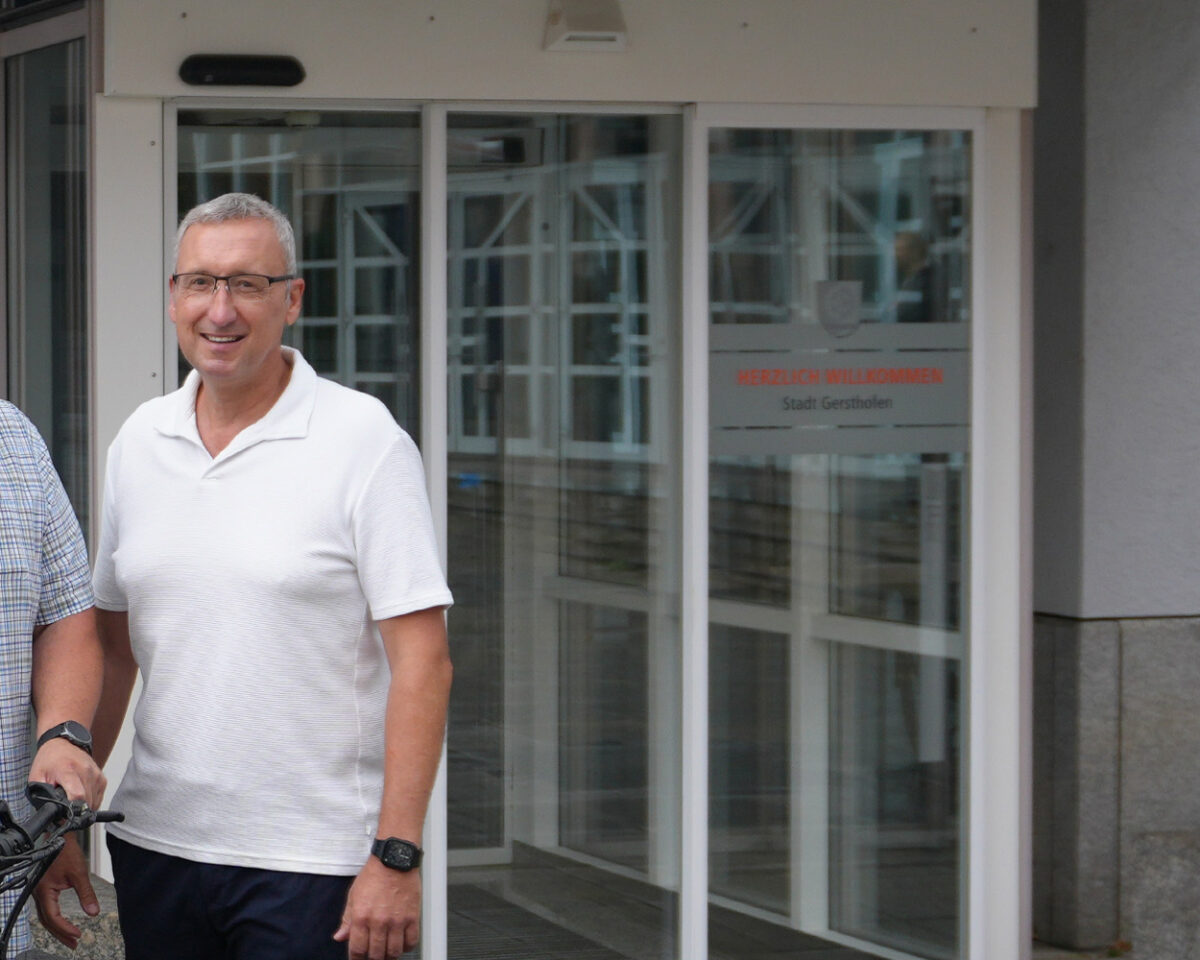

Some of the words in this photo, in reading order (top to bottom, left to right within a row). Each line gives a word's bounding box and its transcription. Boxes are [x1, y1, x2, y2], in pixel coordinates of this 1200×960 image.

[737, 369, 820, 385] HERZLICH
[824, 368, 944, 385] WILLKOMMEN
[783, 395, 816, 411] Stadt
[822, 394, 893, 410] Gersthofen
